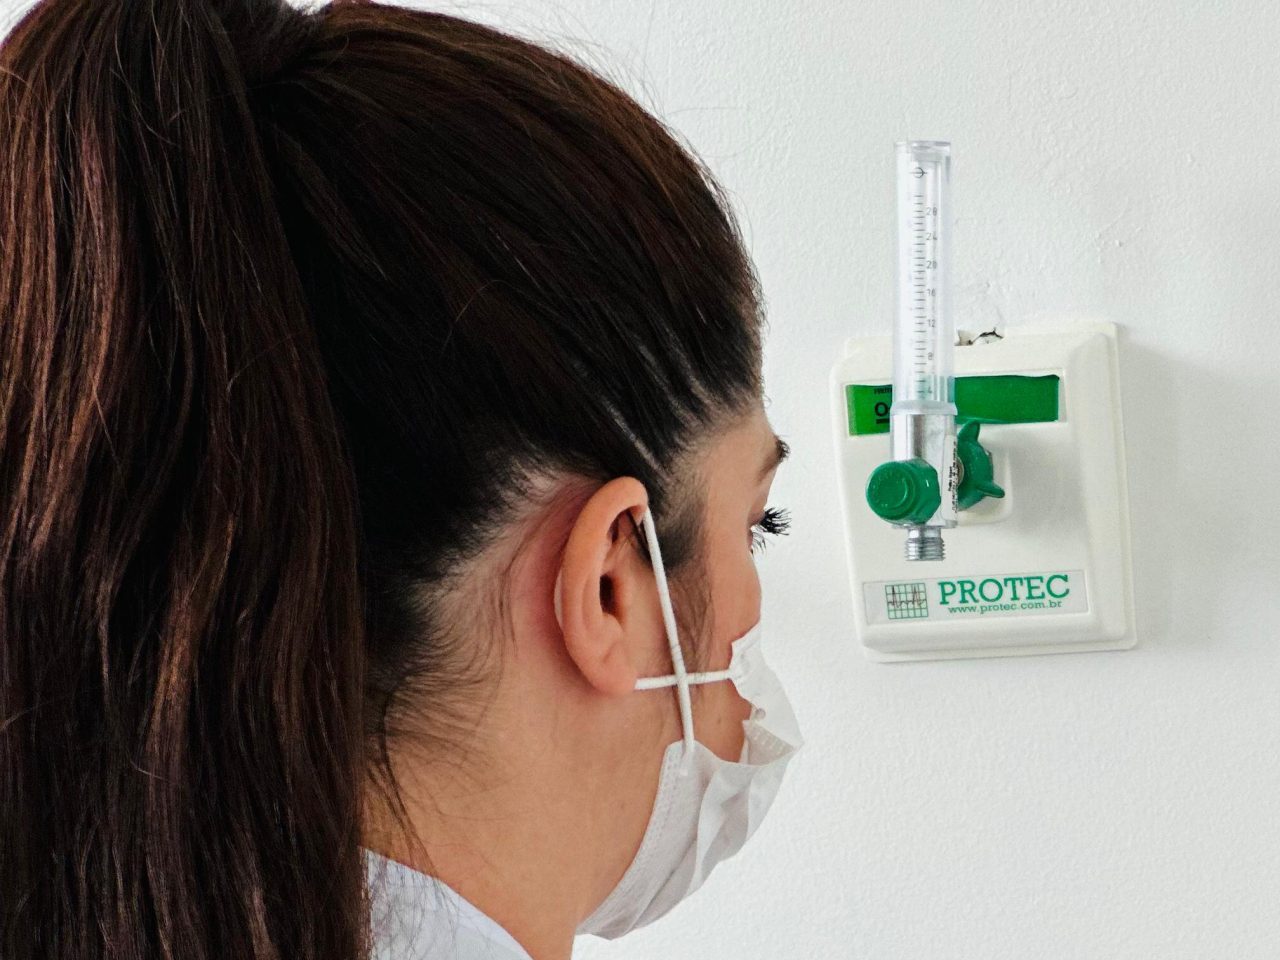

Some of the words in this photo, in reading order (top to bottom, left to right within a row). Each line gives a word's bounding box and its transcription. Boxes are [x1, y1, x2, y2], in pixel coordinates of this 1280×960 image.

[927, 319, 936, 328] 12
[937, 574, 1070, 605] PROTEC
[948, 599, 1062, 614] www.protec.com.br
